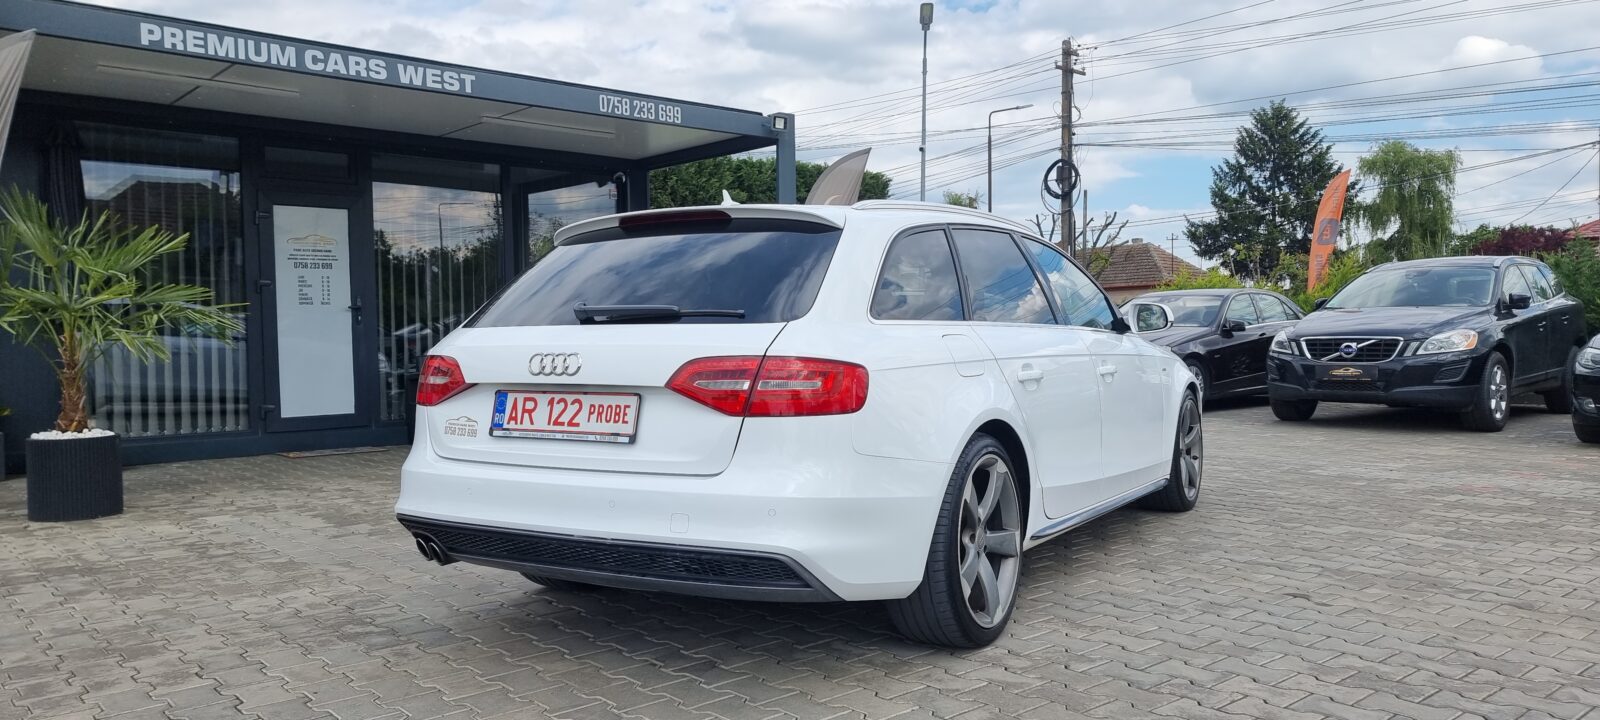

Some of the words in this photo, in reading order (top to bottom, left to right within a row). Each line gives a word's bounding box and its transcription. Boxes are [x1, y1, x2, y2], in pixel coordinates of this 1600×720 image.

[140, 22, 297, 68] PREMIUM
[304, 50, 388, 80] CARS
[397, 63, 476, 94] WEST
[599, 95, 630, 115] 0758
[633, 100, 655, 119] 233
[659, 104, 681, 123] 699
[495, 413, 505, 424] RO
[506, 396, 538, 426] AR
[546, 396, 583, 428] 122
[587, 403, 631, 425] PROBE
